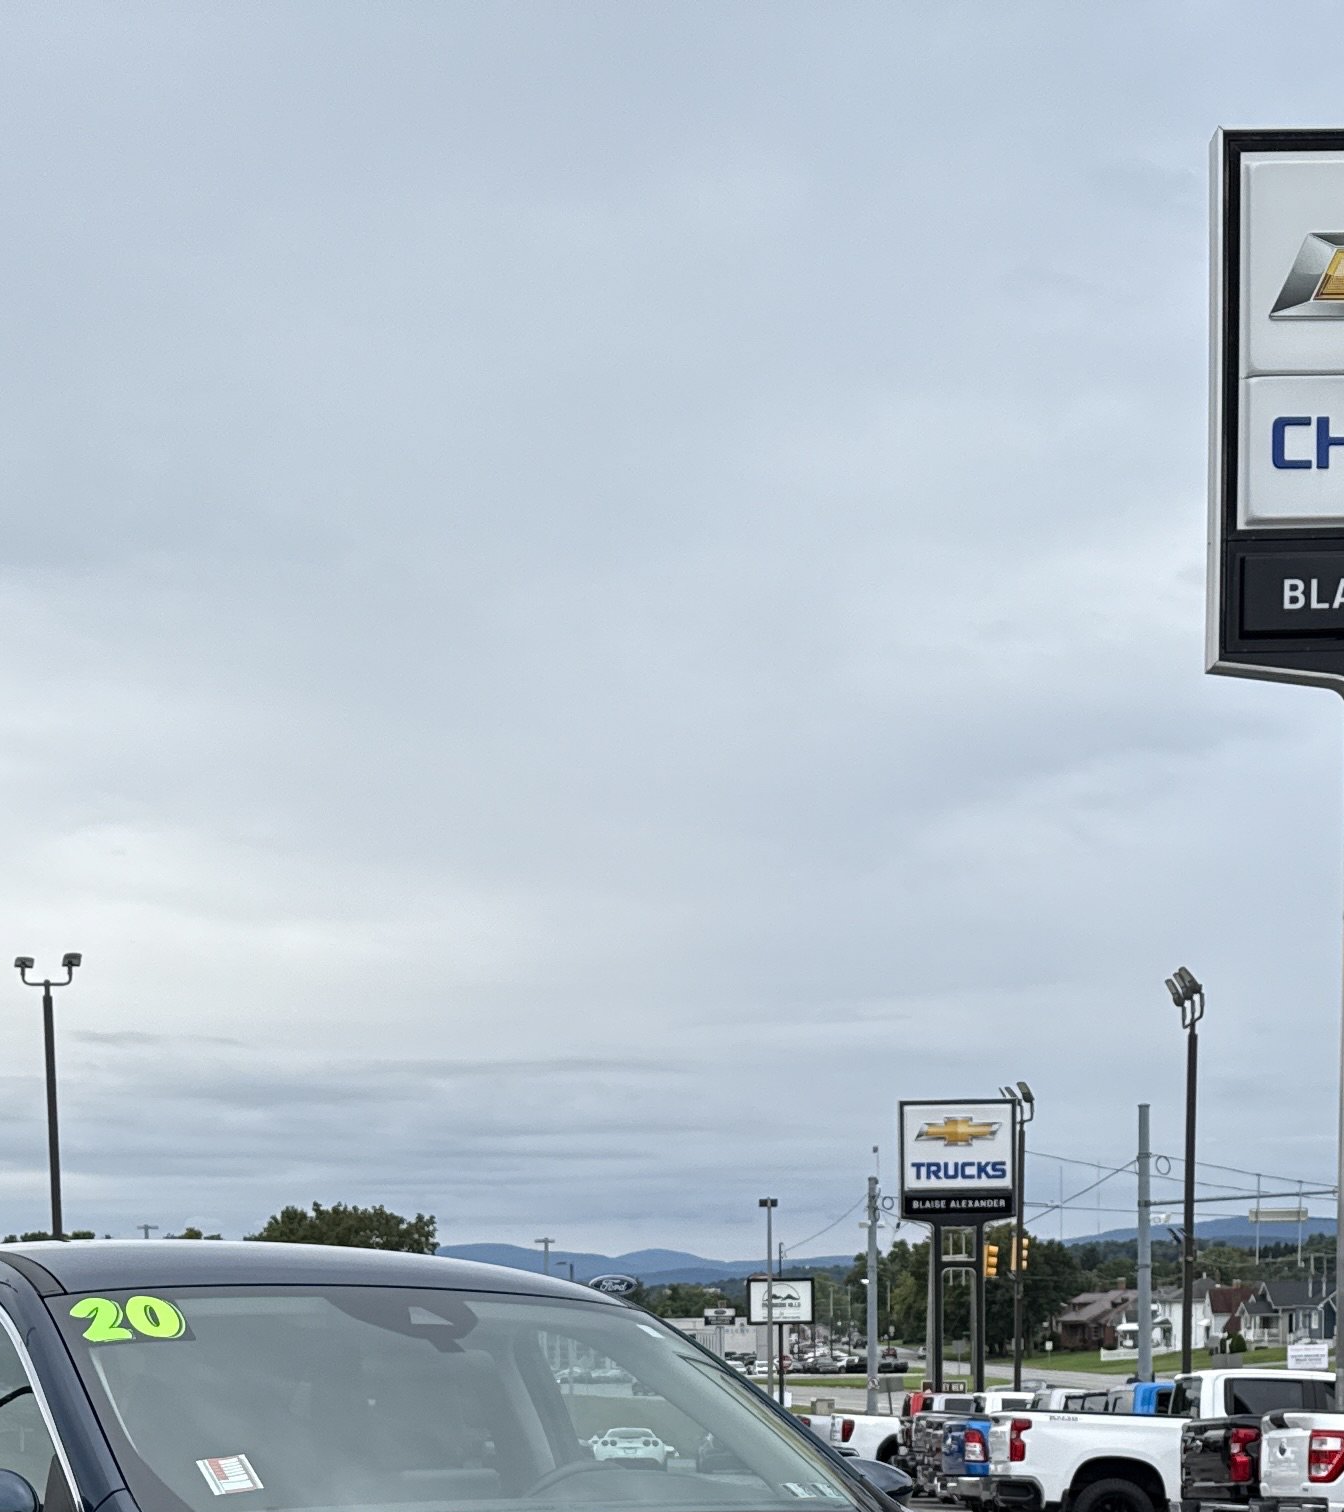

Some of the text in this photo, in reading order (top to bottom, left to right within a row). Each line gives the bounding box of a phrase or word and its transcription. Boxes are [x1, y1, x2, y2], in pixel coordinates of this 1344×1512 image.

[910, 1160, 1007, 1180] TRUCKS
[912, 1198, 1006, 1209] BLAISE ALEXANDER
[69, 1295, 186, 1343] 20
